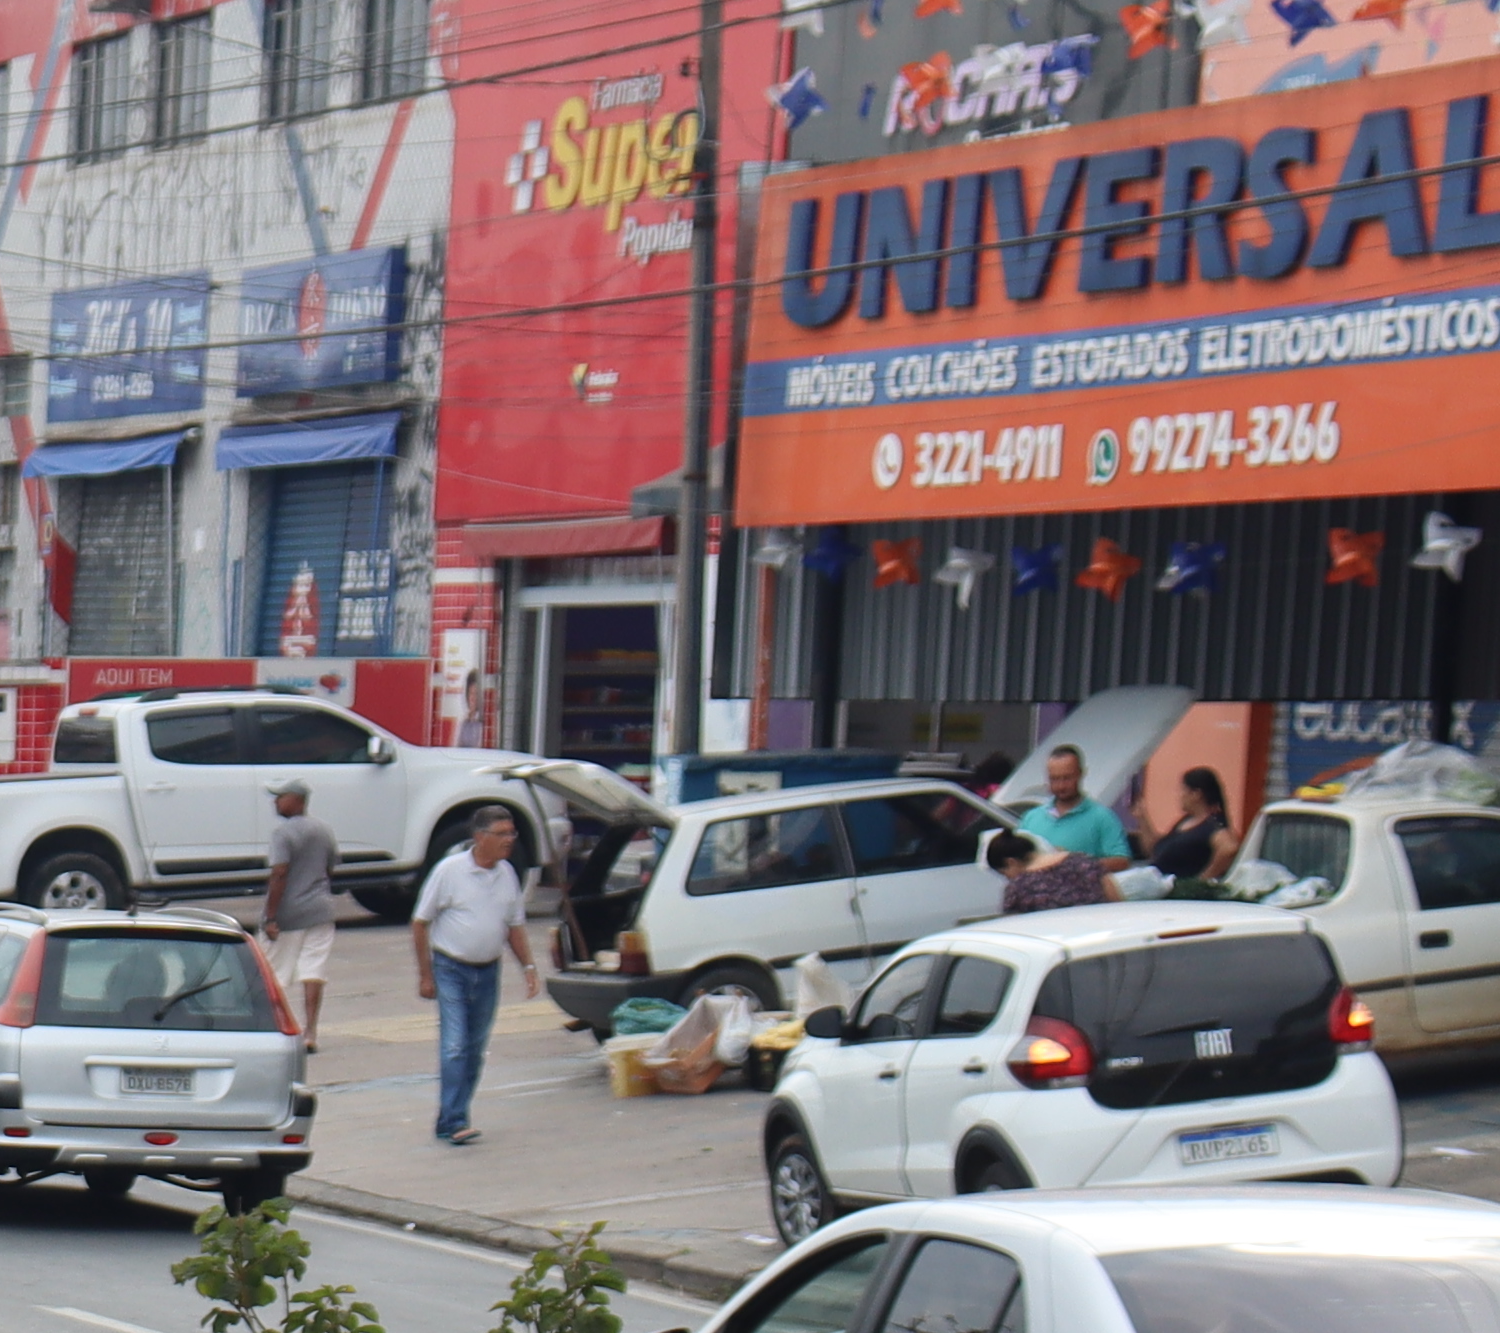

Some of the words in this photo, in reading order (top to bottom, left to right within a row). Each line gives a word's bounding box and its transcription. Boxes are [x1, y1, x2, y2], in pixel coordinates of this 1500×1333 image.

[781, 94, 1500, 328] UNIVERSAL
[787, 355, 875, 407] MÓVEIS
[883, 339, 1018, 401] COLCHÕES
[1029, 328, 1190, 388] ESTOFADOS
[1197, 297, 1500, 374] ELETRODOMÉSTICOS
[911, 423, 1063, 487] 3221-4911
[1127, 401, 1340, 473] 99274-3266
[96, 668, 133, 685] AQUI
[139, 668, 173, 685] TEM
[1194, 1029, 1232, 1058] FIAT
